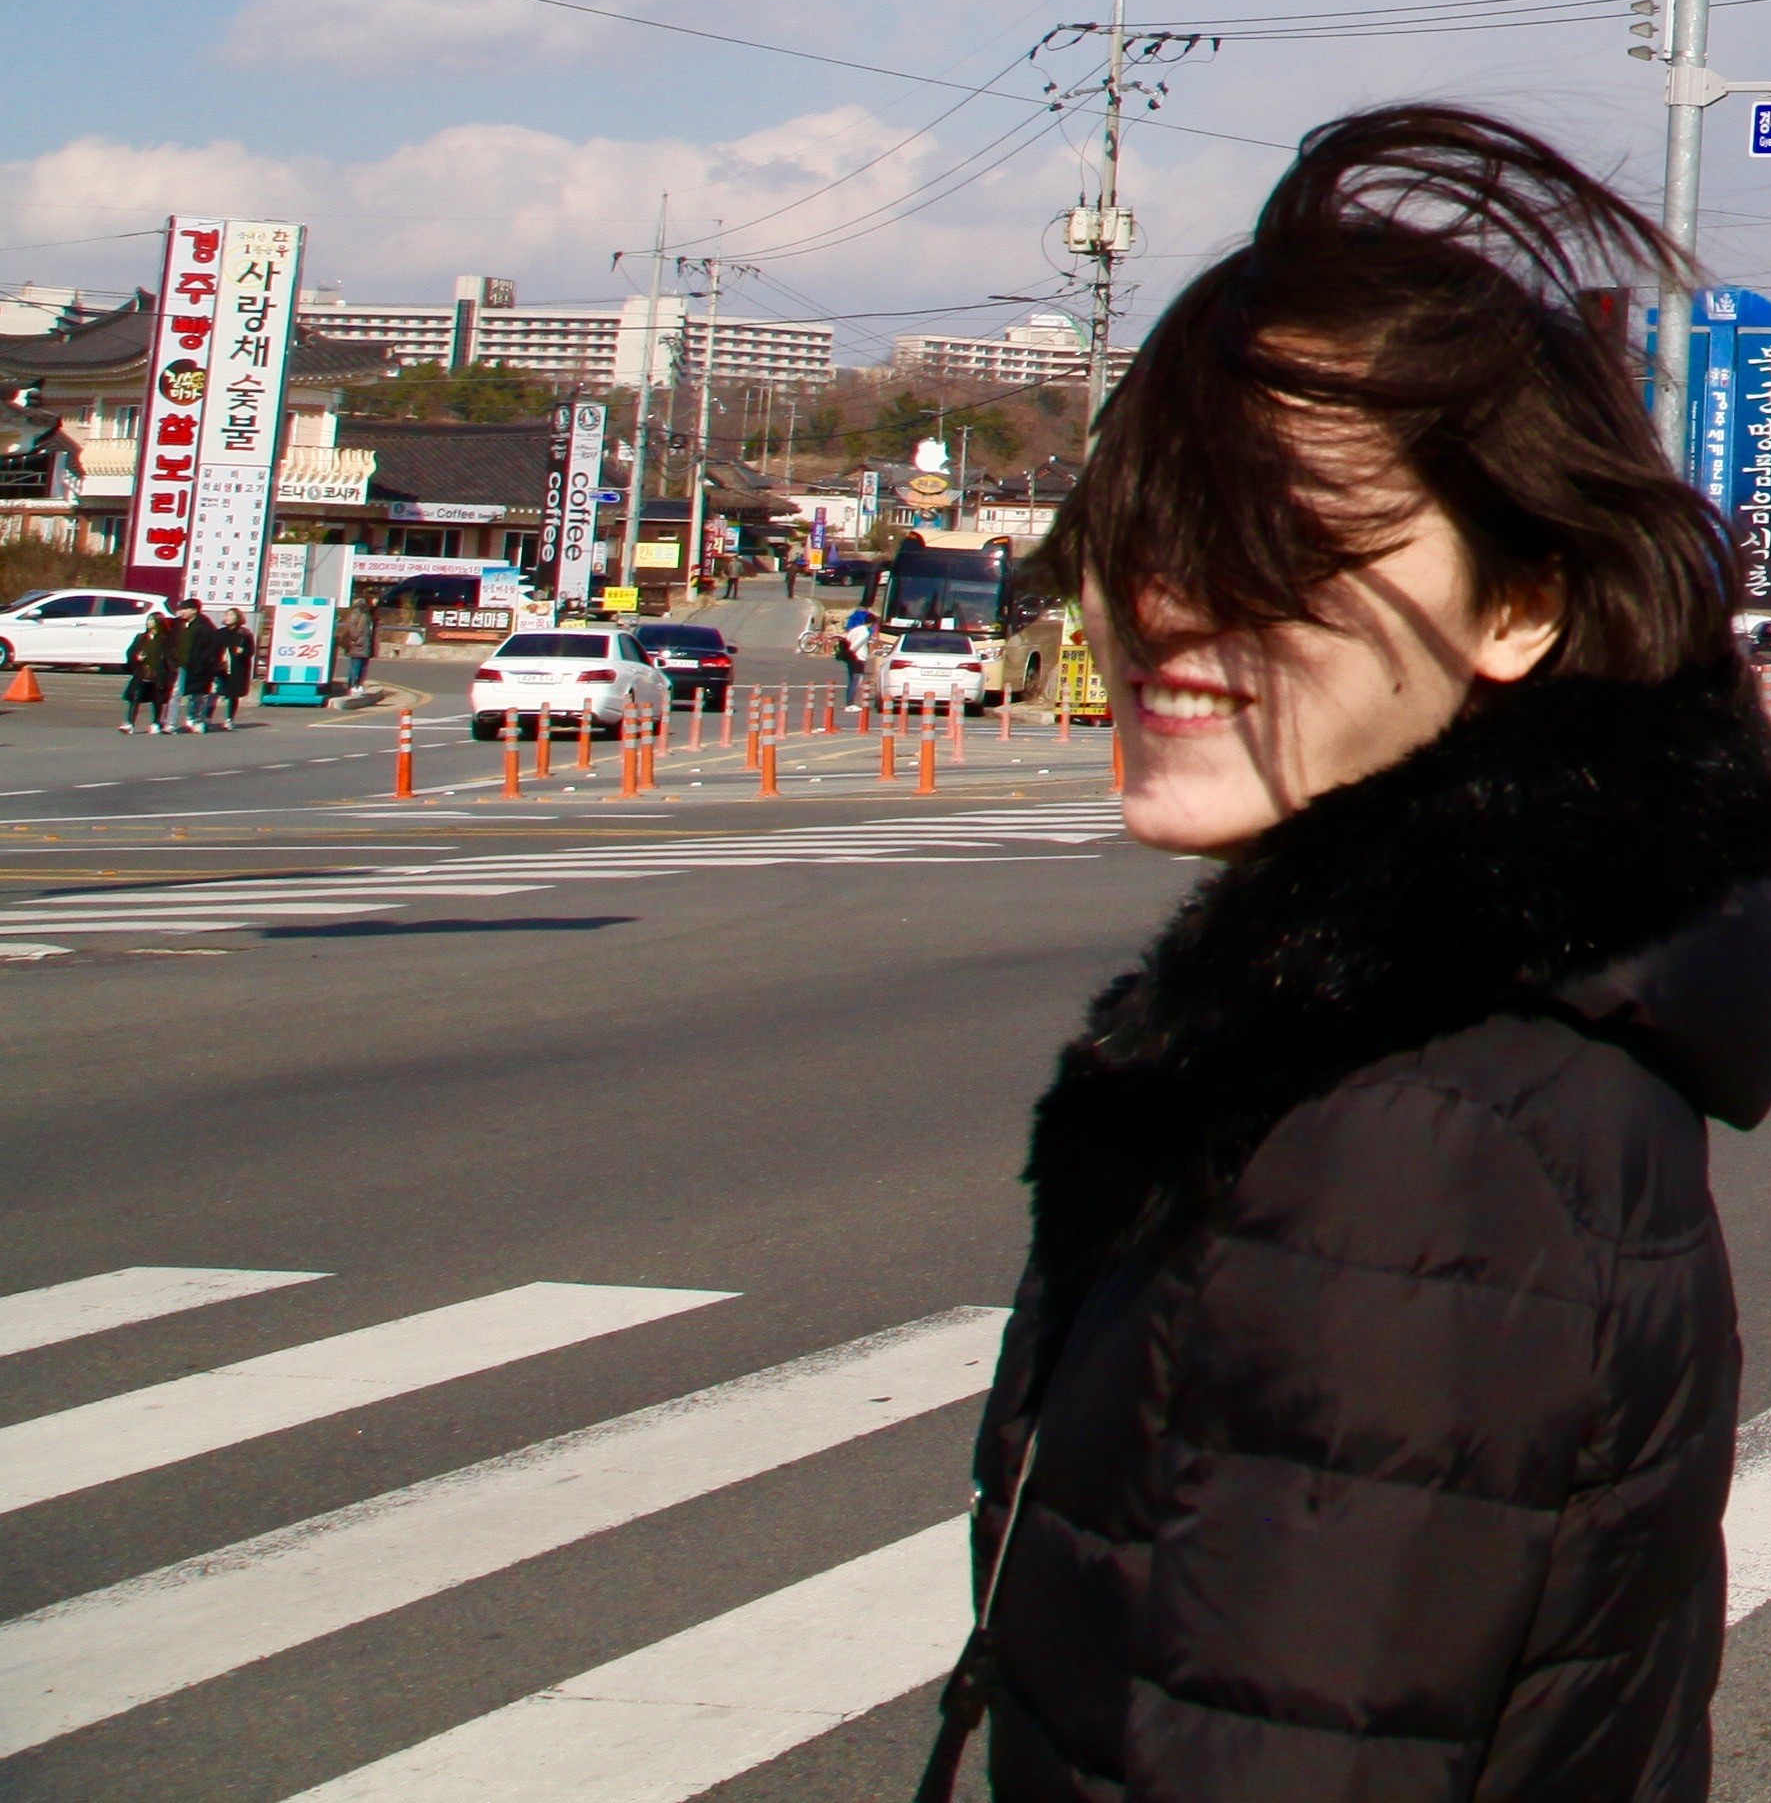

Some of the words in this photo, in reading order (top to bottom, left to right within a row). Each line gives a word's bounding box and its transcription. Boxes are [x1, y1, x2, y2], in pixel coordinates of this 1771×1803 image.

[171, 229, 220, 350] 경주빵
[146, 413, 199, 560] 찰보리빵
[436, 508, 476, 519] Coffee
[541, 471, 562, 562] coffee
[565, 471, 592, 562] coffee
[277, 644, 324, 660] GS25
